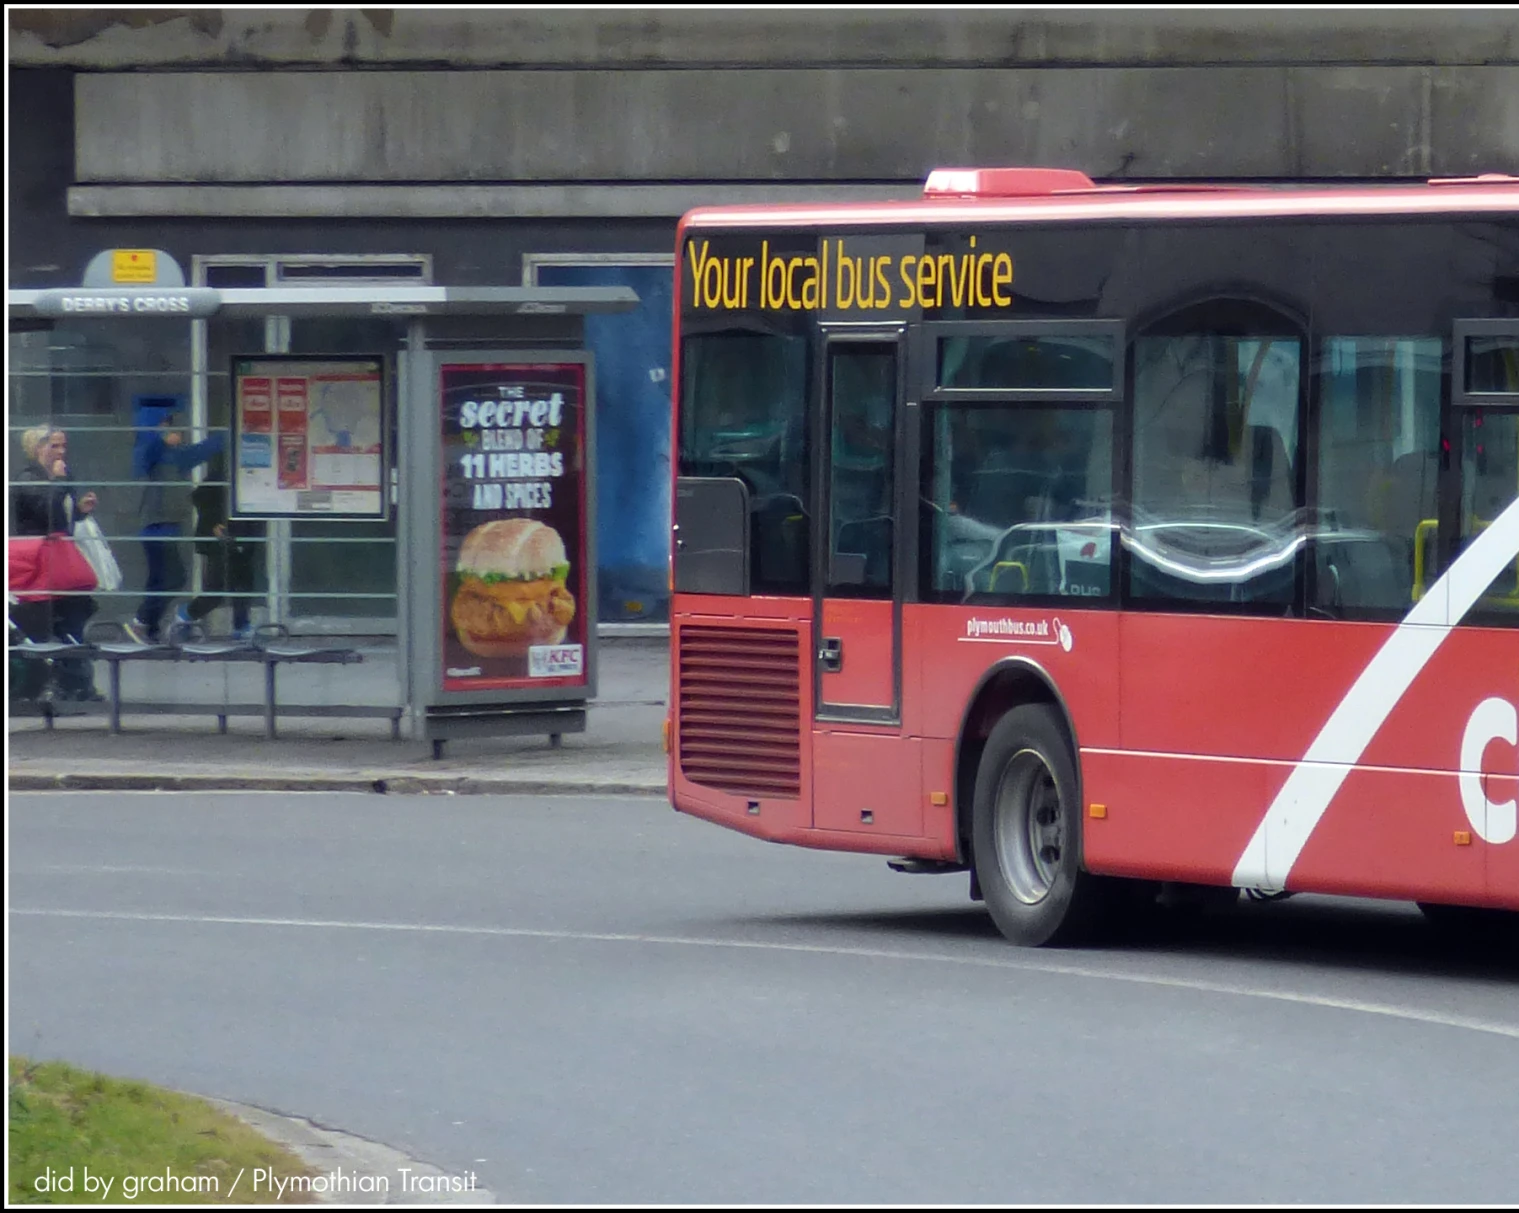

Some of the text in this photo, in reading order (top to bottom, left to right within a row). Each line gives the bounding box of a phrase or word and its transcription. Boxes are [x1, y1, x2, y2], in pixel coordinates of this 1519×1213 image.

[688, 234, 1013, 309] Your local bus service
[61, 297, 190, 313] DERRY'S CROSS
[498, 386, 525, 399] THE
[459, 392, 565, 428] secret
[481, 427, 545, 450] BLEND OF
[459, 451, 564, 479] 11 HERBS
[472, 481, 552, 510] AND SPICES
[967, 617, 1049, 636] plymouthbus.co.uk
